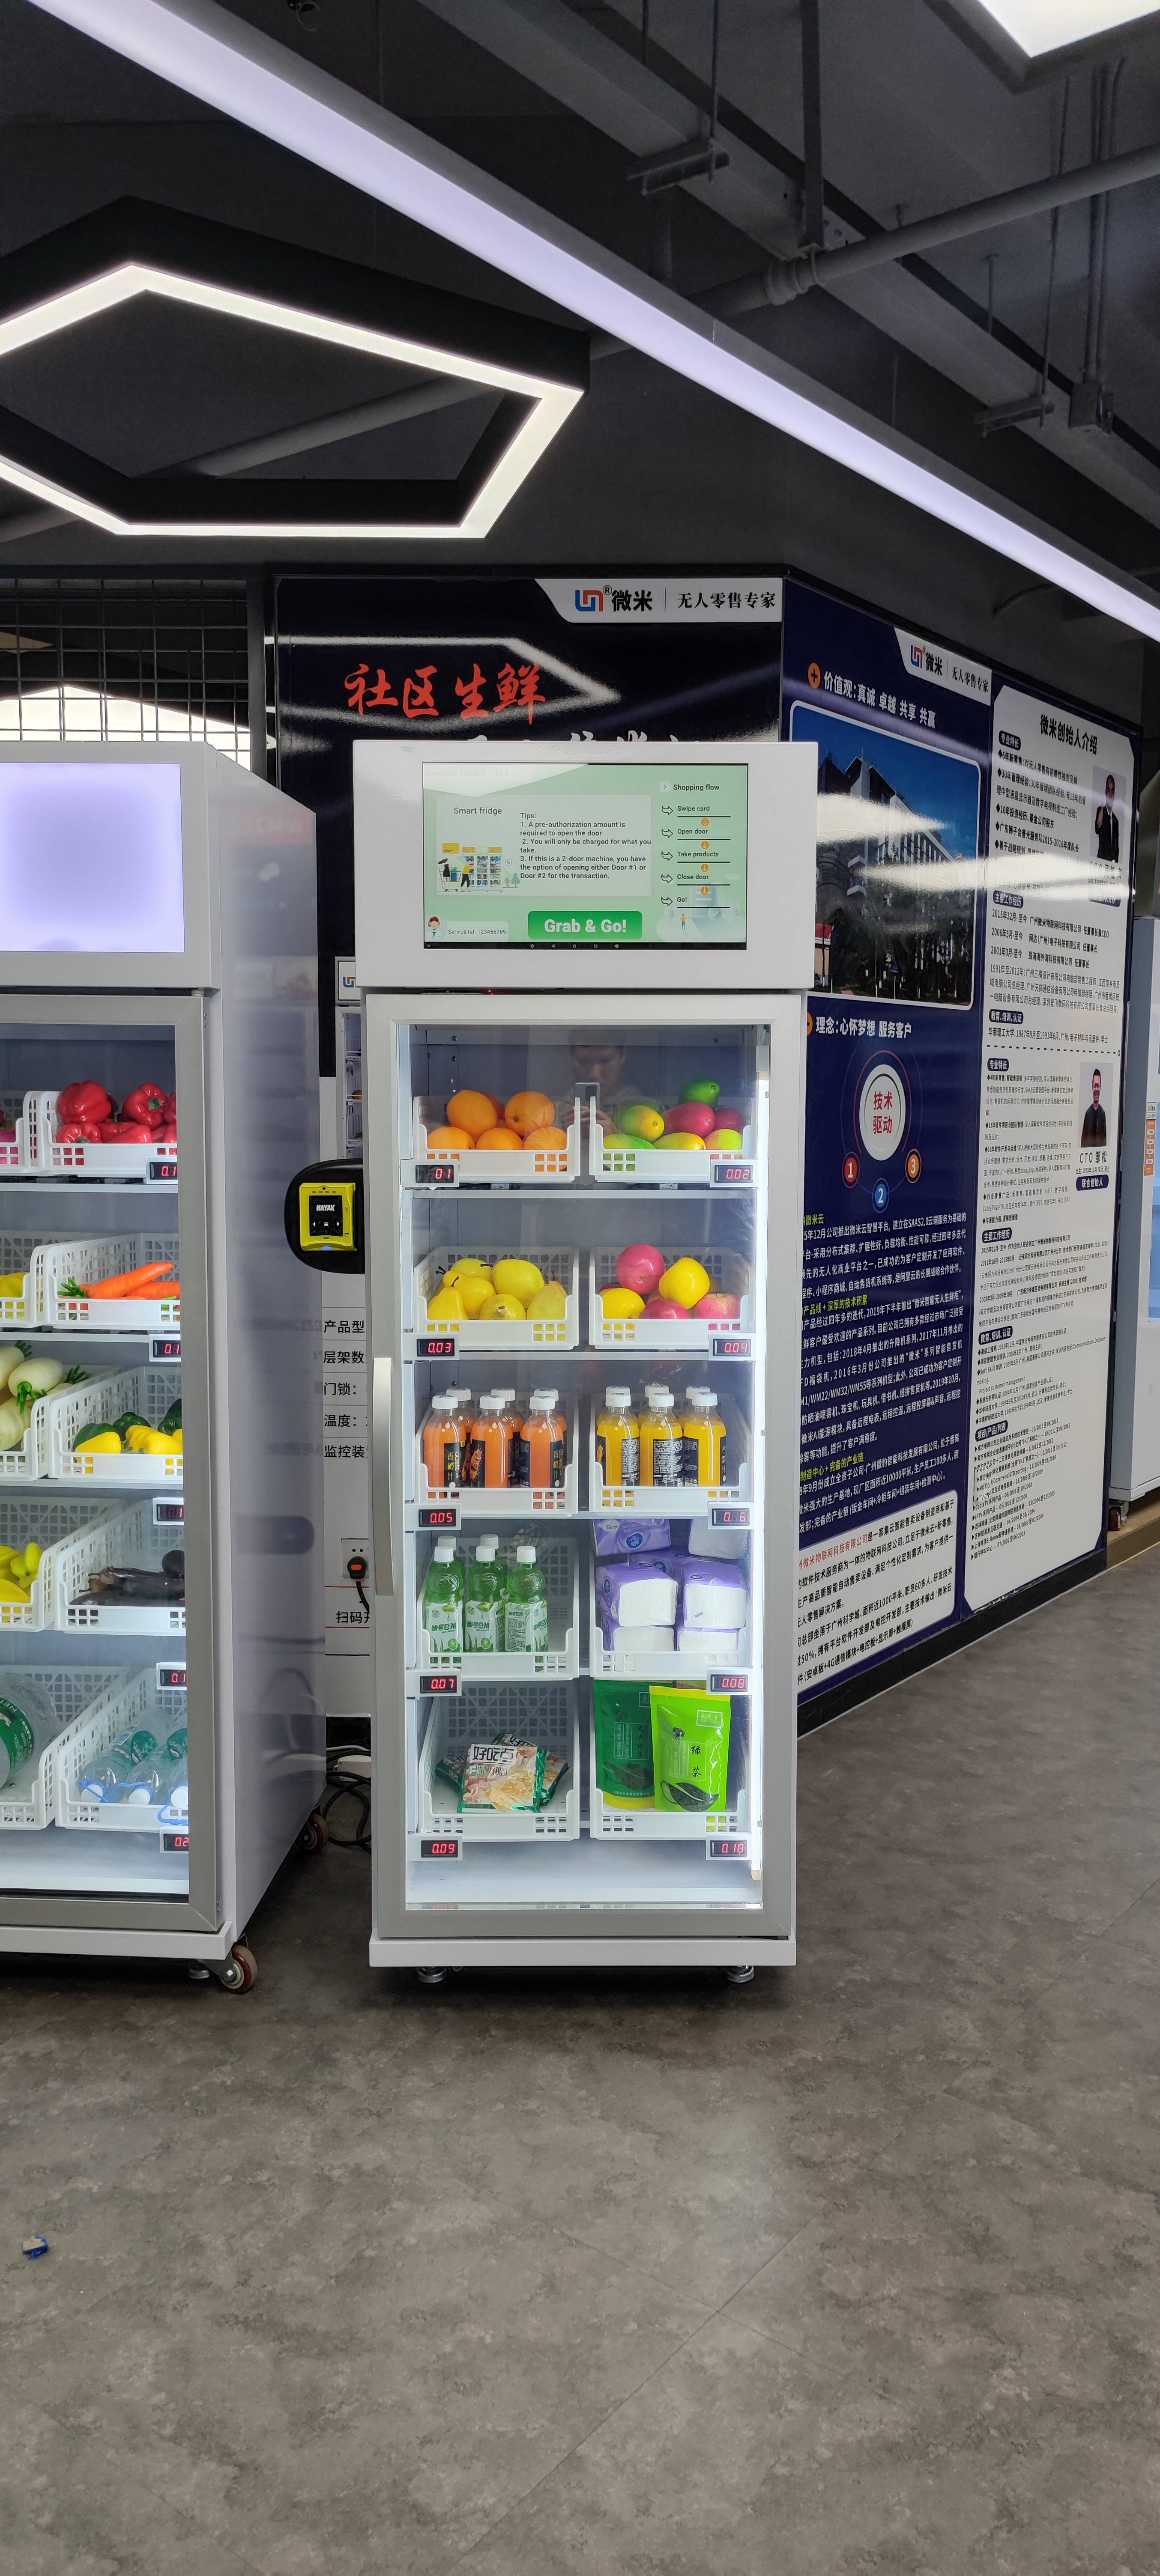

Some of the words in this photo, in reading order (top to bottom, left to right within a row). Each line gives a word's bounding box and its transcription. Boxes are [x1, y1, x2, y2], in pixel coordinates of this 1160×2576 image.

[612, 590, 652, 612] 微米
[677, 591, 776, 609] 无人零售专家
[925, 652, 943, 677] 微米
[951, 666, 988, 693] 无人零售专家
[345, 662, 545, 725] 社区生鲜
[879, 692, 897, 714] 卓越
[900, 699, 916, 721] 共享
[920, 707, 936, 729] 共赢
[1001, 733, 1019, 748] 专业特长
[1040, 714, 1097, 755] 微米创始人介绍
[479, 807, 502, 816] fridge
[557, 838, 571, 846] only
[582, 838, 609, 846] charged
[995, 893, 1021, 907] 主要工作经历
[544, 918, 581, 933] Grab
[585, 919, 596, 933] &
[601, 919, 626, 933] Go!
[1029, 916, 1081, 934] 广州微米物联网科技有限公司
[1082, 942, 1097, 954] 任董事长
[1074, 958, 1089, 969] 任董事长
[879, 1021, 912, 1039] 服务客户
[990, 1060, 1007, 1070] 专业特长
[873, 1091, 893, 1111] 技术
[873, 1115, 892, 1134] 驱动
[1079, 1152, 1093, 1163] CTO
[848, 1162, 853, 1178] 1
[911, 1159, 916, 1174] 3
[1082, 1177, 1103, 1188] 联合创始人
[878, 1188, 884, 1204] 2
[804, 1213, 824, 1226] 微米云
[984, 1229, 1010, 1242] 主要工作经历
[802, 1303, 822, 1316] 产品线
[827, 1294, 867, 1312] 深厚的技术积累
[323, 1320, 365, 1333] 产品型
[323, 1351, 367, 1364] 层架数
[324, 1445, 368, 1458] 监控装
[800, 1464, 824, 1481] 制造中心
[829, 1452, 864, 1473] 完备的产业链
[429, 1512, 453, 1523] 0.05
[431, 1622, 456, 1631] 빠른단계
[467, 1620, 490, 1628] 빠른단계
[431, 1679, 455, 1690] 0.07
[472, 1746, 514, 1763] 好吃点
[691, 1745, 702, 1778] 绿茶
[432, 1843, 455, 1854] 0.09
